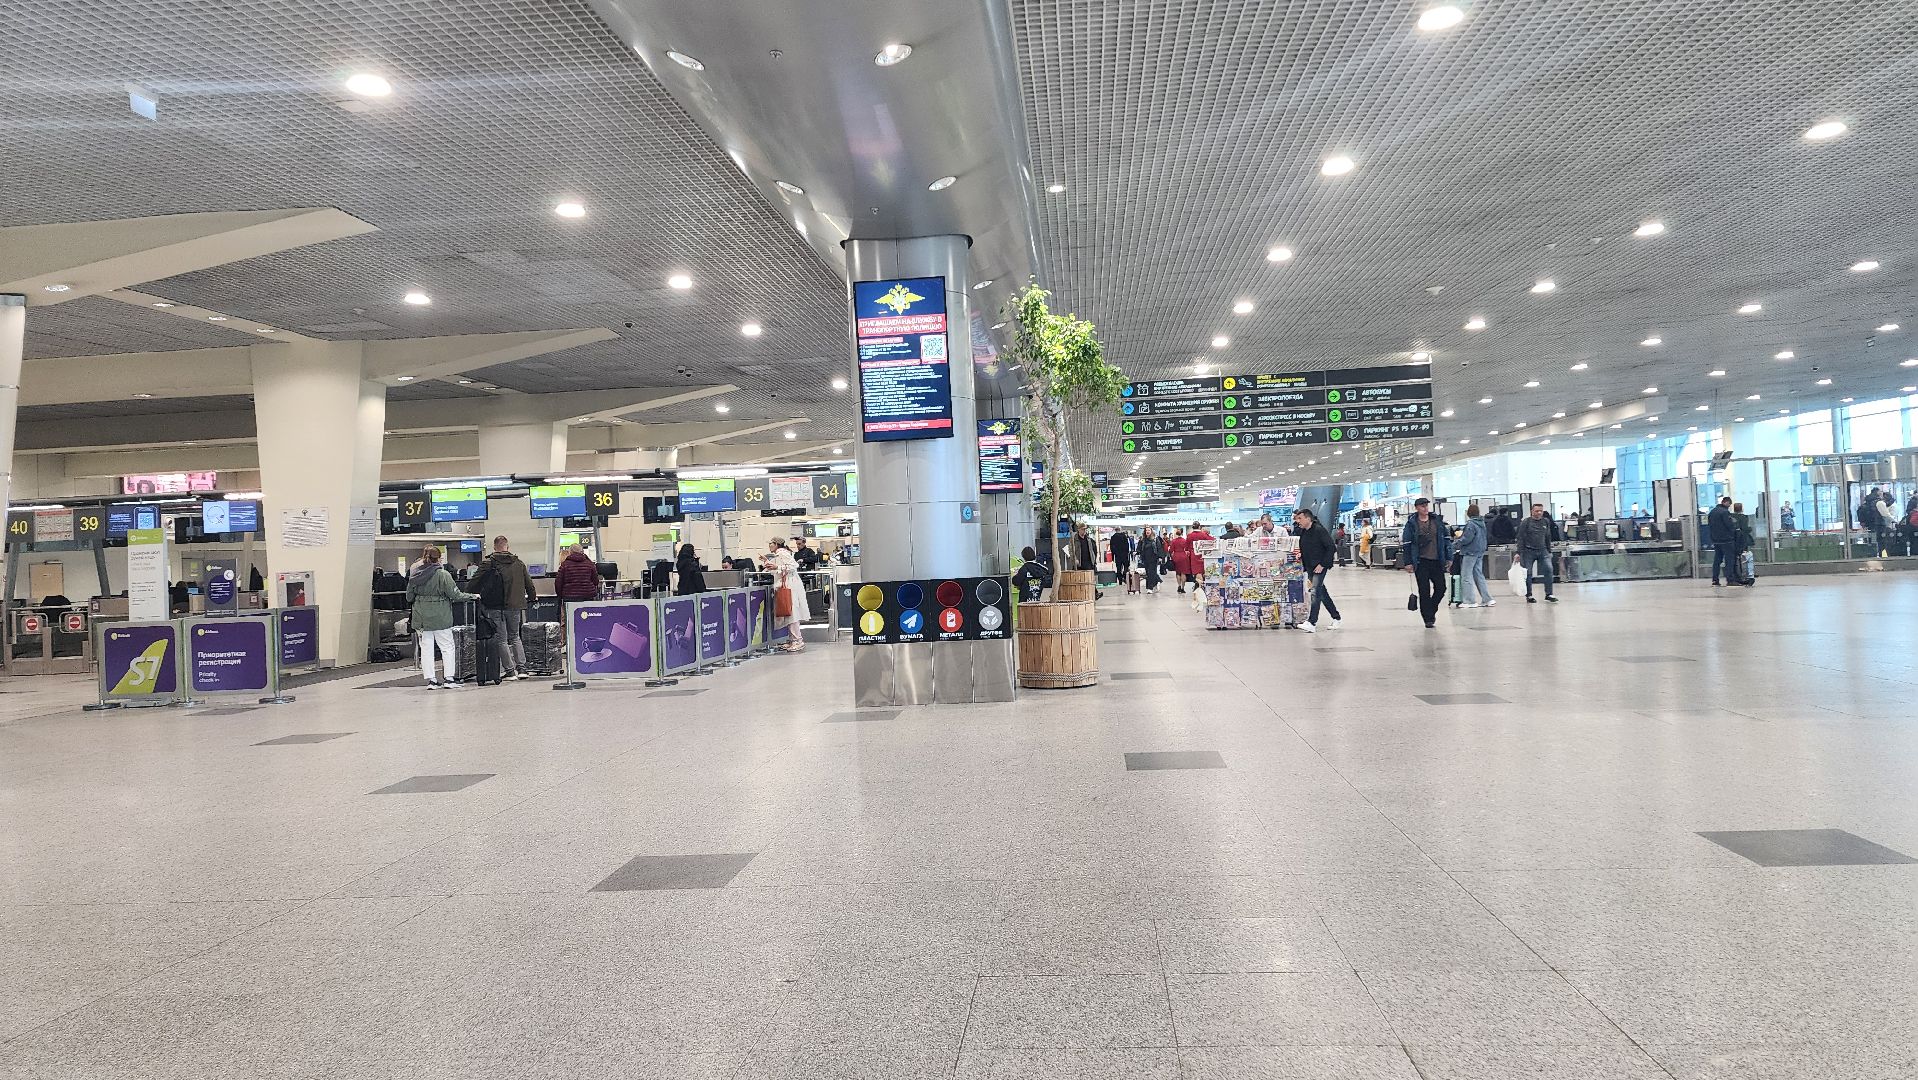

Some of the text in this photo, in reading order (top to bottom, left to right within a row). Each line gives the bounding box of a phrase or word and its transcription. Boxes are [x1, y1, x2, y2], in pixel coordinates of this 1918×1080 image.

[744, 487, 764, 503] 35
[820, 484, 840, 499] 34
[594, 492, 613, 507] 36
[406, 502, 424, 516] 37
[10, 520, 28, 535] 40
[80, 516, 99, 531] 39
[198, 651, 247, 659] Приоритетная
[199, 659, 242, 667] регистрация
[129, 656, 160, 686] S7
